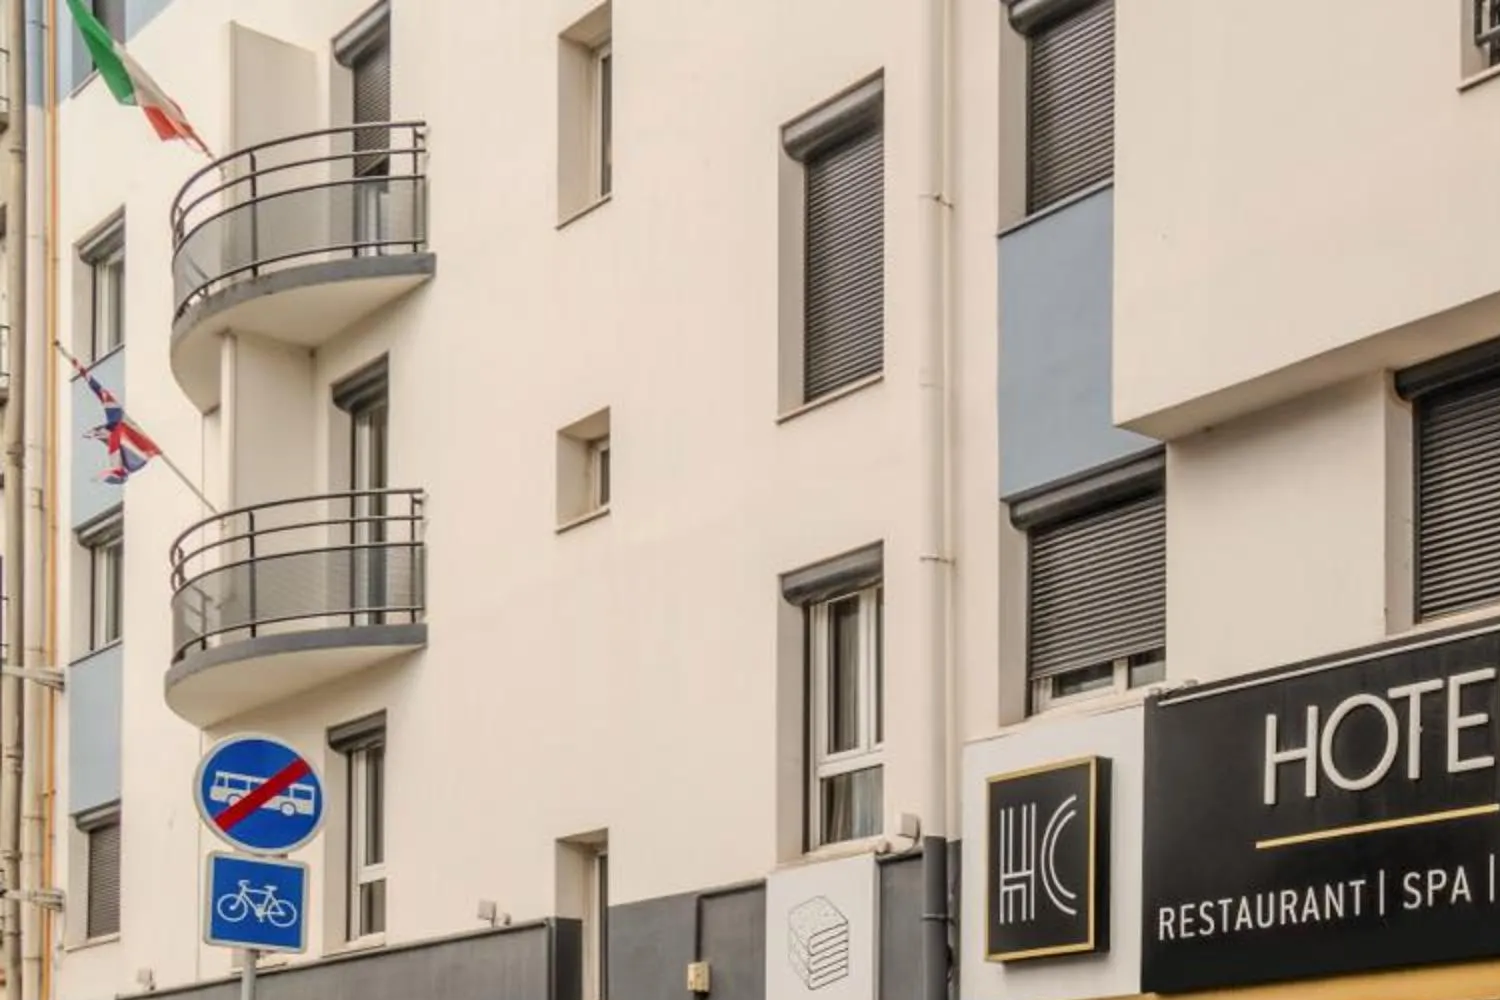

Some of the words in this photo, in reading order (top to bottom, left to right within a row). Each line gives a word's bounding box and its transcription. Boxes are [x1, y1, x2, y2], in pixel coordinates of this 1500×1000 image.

[1000, 793, 1077, 924] HC
[1158, 878, 1366, 941] RESTAURANT
[1402, 865, 1471, 910] SPA
